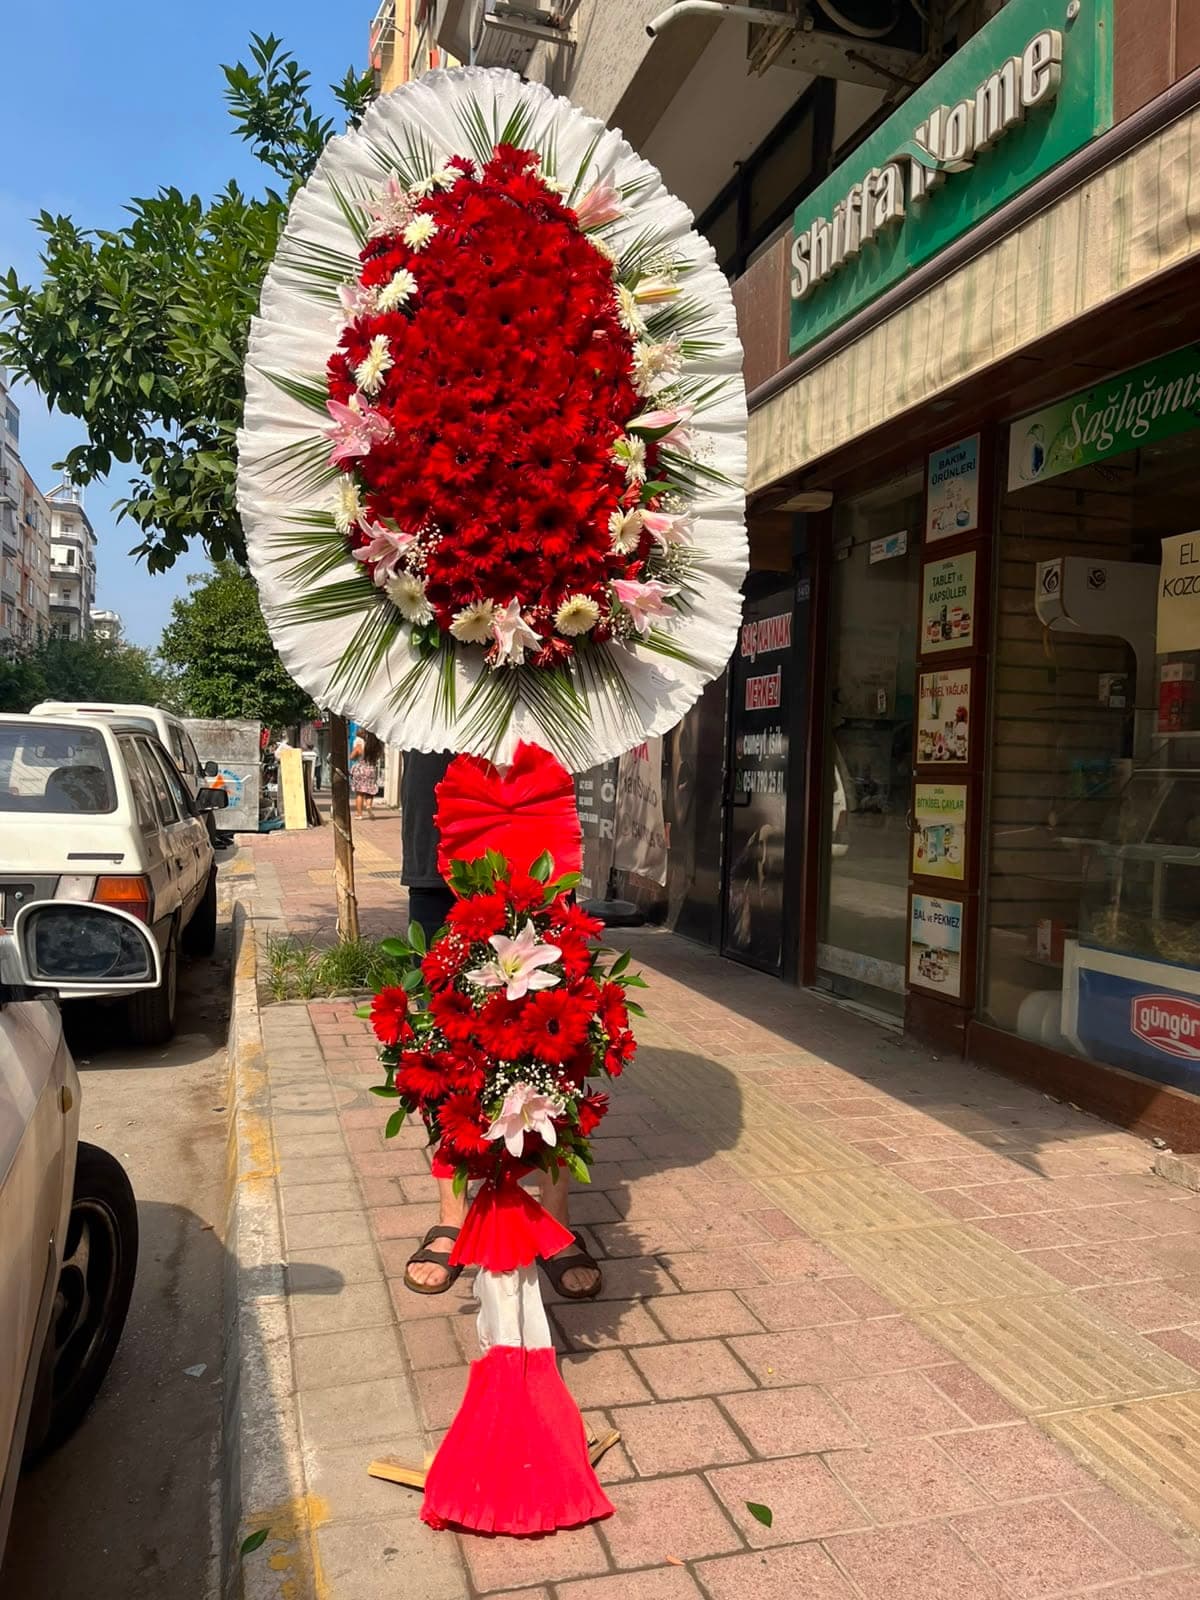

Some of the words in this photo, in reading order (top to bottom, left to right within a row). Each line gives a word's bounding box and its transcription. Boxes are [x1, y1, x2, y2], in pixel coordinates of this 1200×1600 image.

[931, 457, 976, 486] ÜRÜNLERİ
[938, 450, 967, 470] BAKIM
[1179, 542, 1199, 565] EL
[932, 572, 956, 587] TABLET
[928, 585, 967, 604] KAPSÜLLER
[757, 611, 792, 654] KAYNAK
[744, 665, 782, 711] MERKEZİ
[914, 909, 926, 921] BAL
[933, 912, 960, 929] PEKMEZ
[1140, 1004, 1200, 1040] güngör
